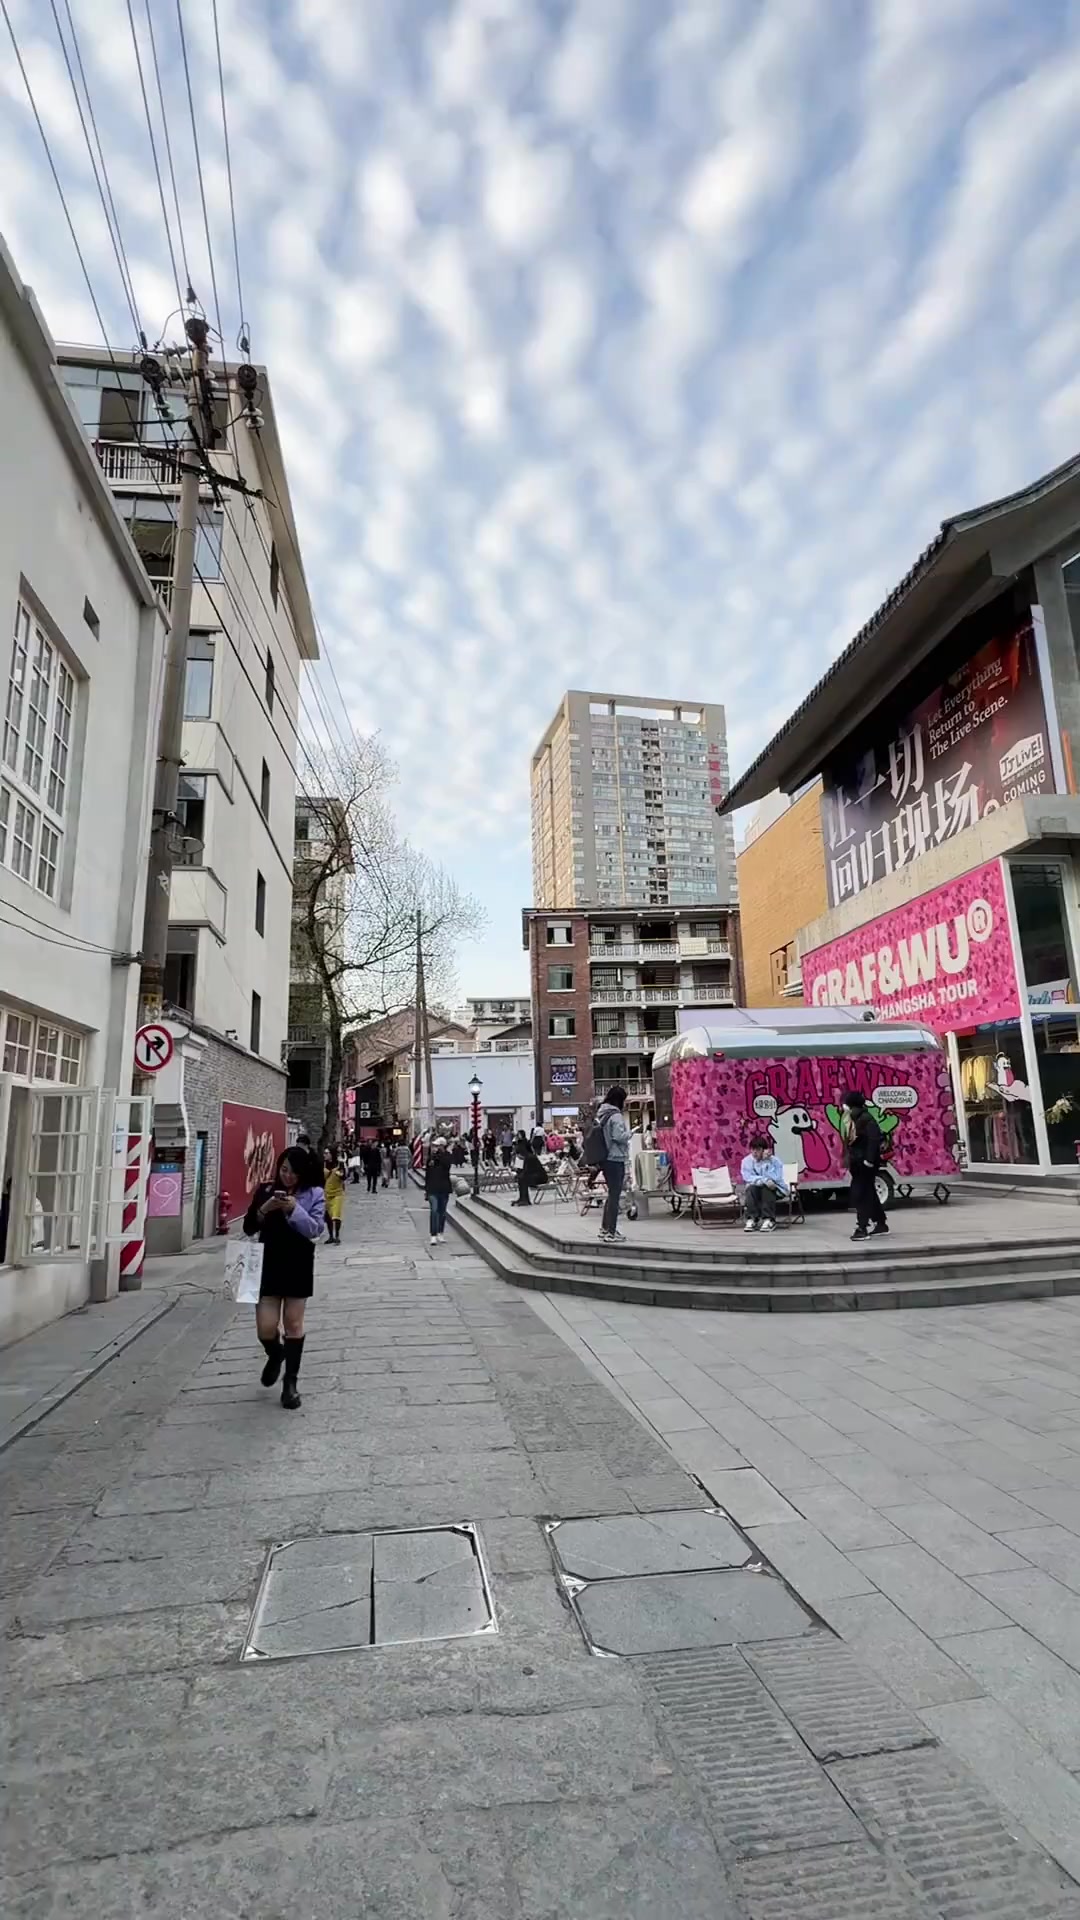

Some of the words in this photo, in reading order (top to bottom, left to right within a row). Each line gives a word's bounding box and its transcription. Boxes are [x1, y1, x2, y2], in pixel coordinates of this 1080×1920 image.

[943, 658, 1003, 713] Everything
[929, 711, 962, 745] Return
[963, 700, 976, 716] to
[929, 736, 949, 760] The
[949, 721, 972, 746] Live
[972, 696, 1008, 728] Scene.
[1003, 769, 1046, 804] COMING
[938, 979, 979, 1005] TOUR
